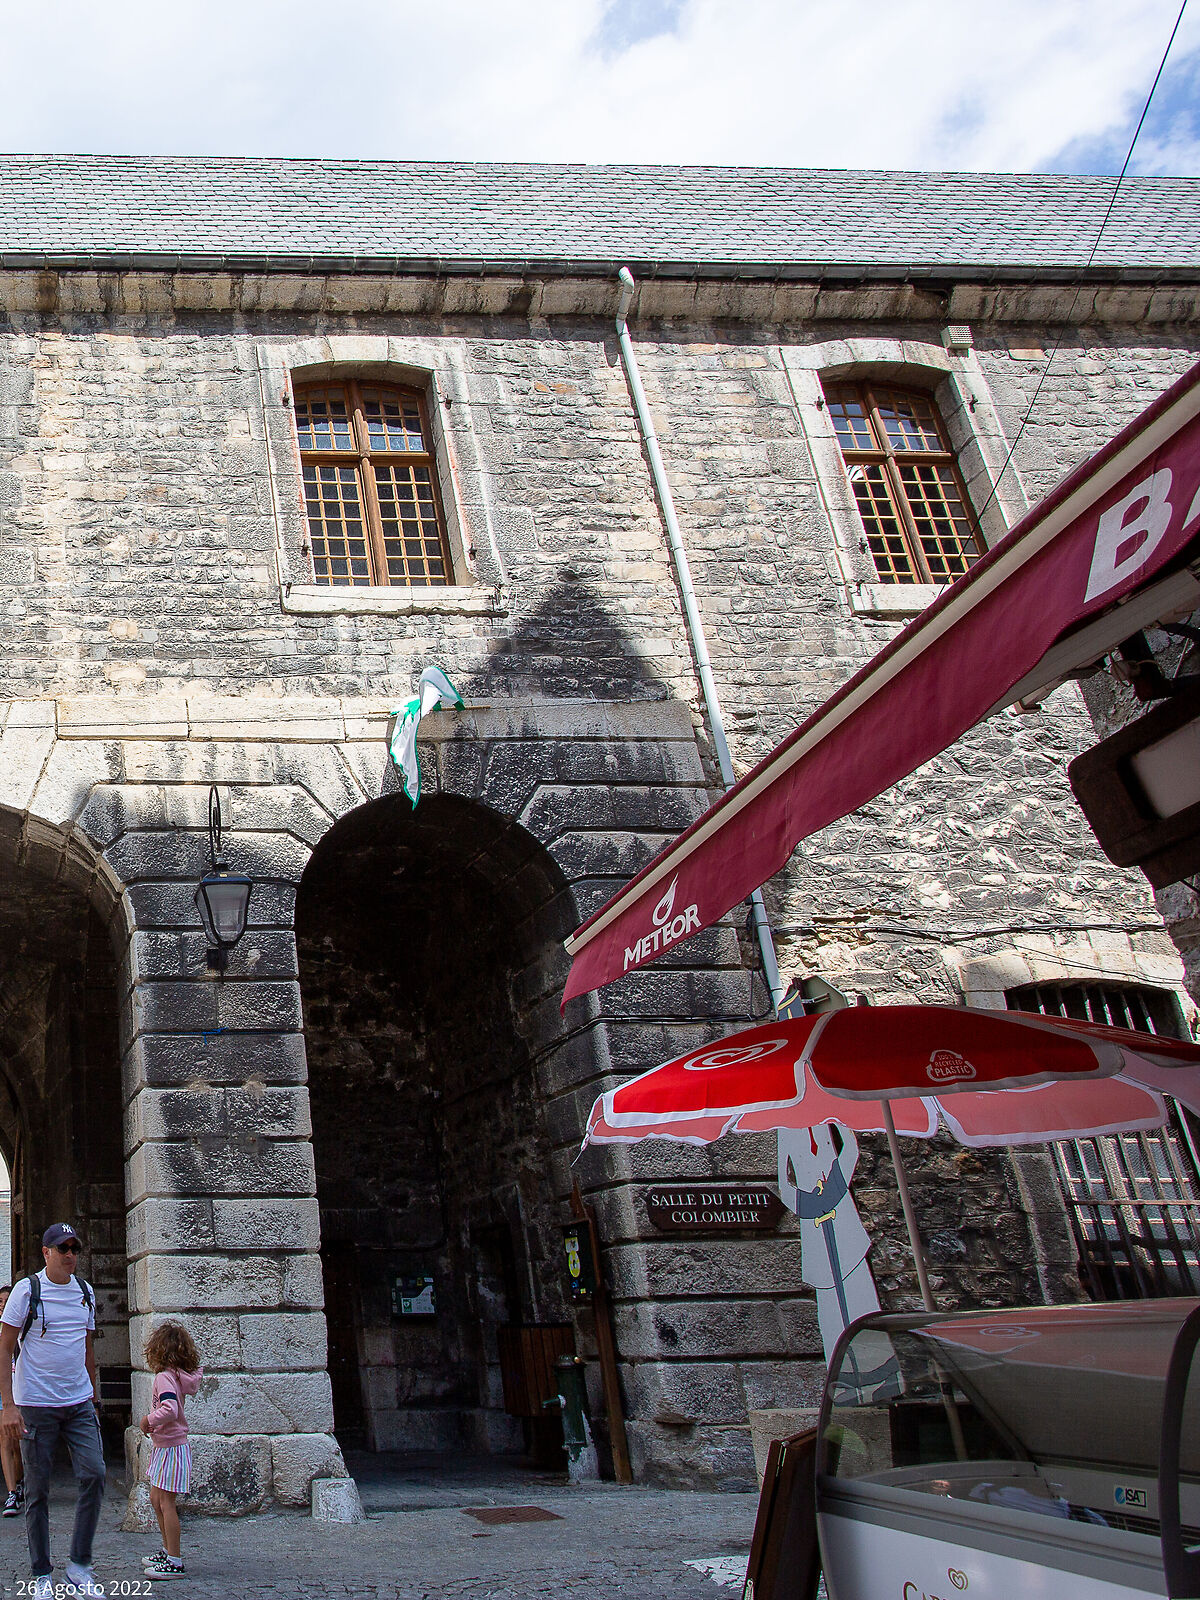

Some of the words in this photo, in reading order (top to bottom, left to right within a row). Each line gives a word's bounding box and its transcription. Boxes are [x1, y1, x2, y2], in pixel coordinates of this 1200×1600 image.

[1083, 467, 1200, 604] B
[623, 903, 702, 972] METEOR
[651, 1193, 697, 1207] SALLE
[701, 1193, 723, 1206] DU
[727, 1193, 770, 1207] PETIT
[671, 1210, 760, 1223] COLOMBIER
